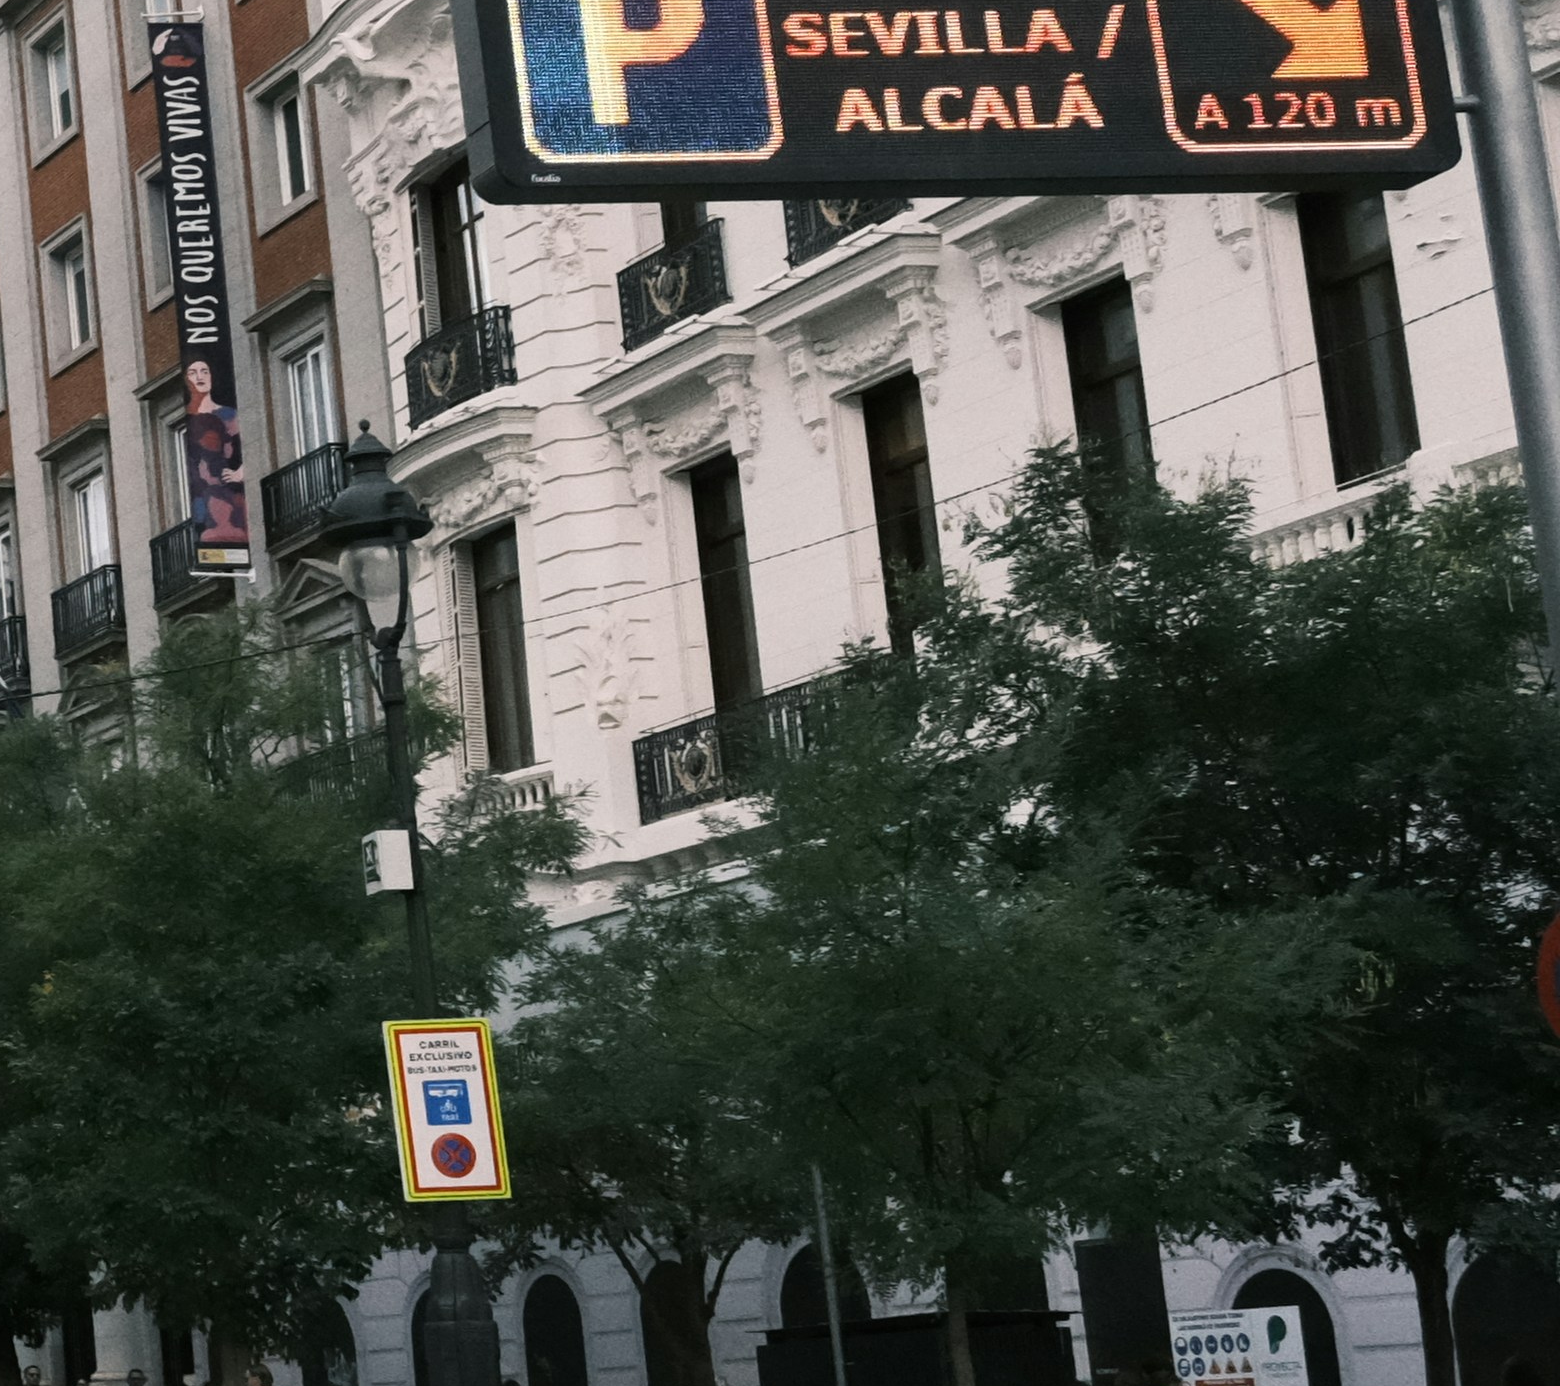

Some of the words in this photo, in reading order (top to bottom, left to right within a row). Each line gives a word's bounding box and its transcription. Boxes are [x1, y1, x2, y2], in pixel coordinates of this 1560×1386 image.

[782, 10, 1071, 59] SEVILLA
[162, 73, 203, 144] VIVAS
[834, 72, 1106, 133] ALCALÁ
[1193, 93, 1230, 132] A
[1246, 91, 1337, 131] 120
[1354, 95, 1402, 128] m
[172, 150, 217, 284] QUEREMOS
[185, 292, 219, 345] NOS
[409, 1051, 473, 1062] EXCLUSIVO
[418, 1040, 460, 1050] CARRIL
